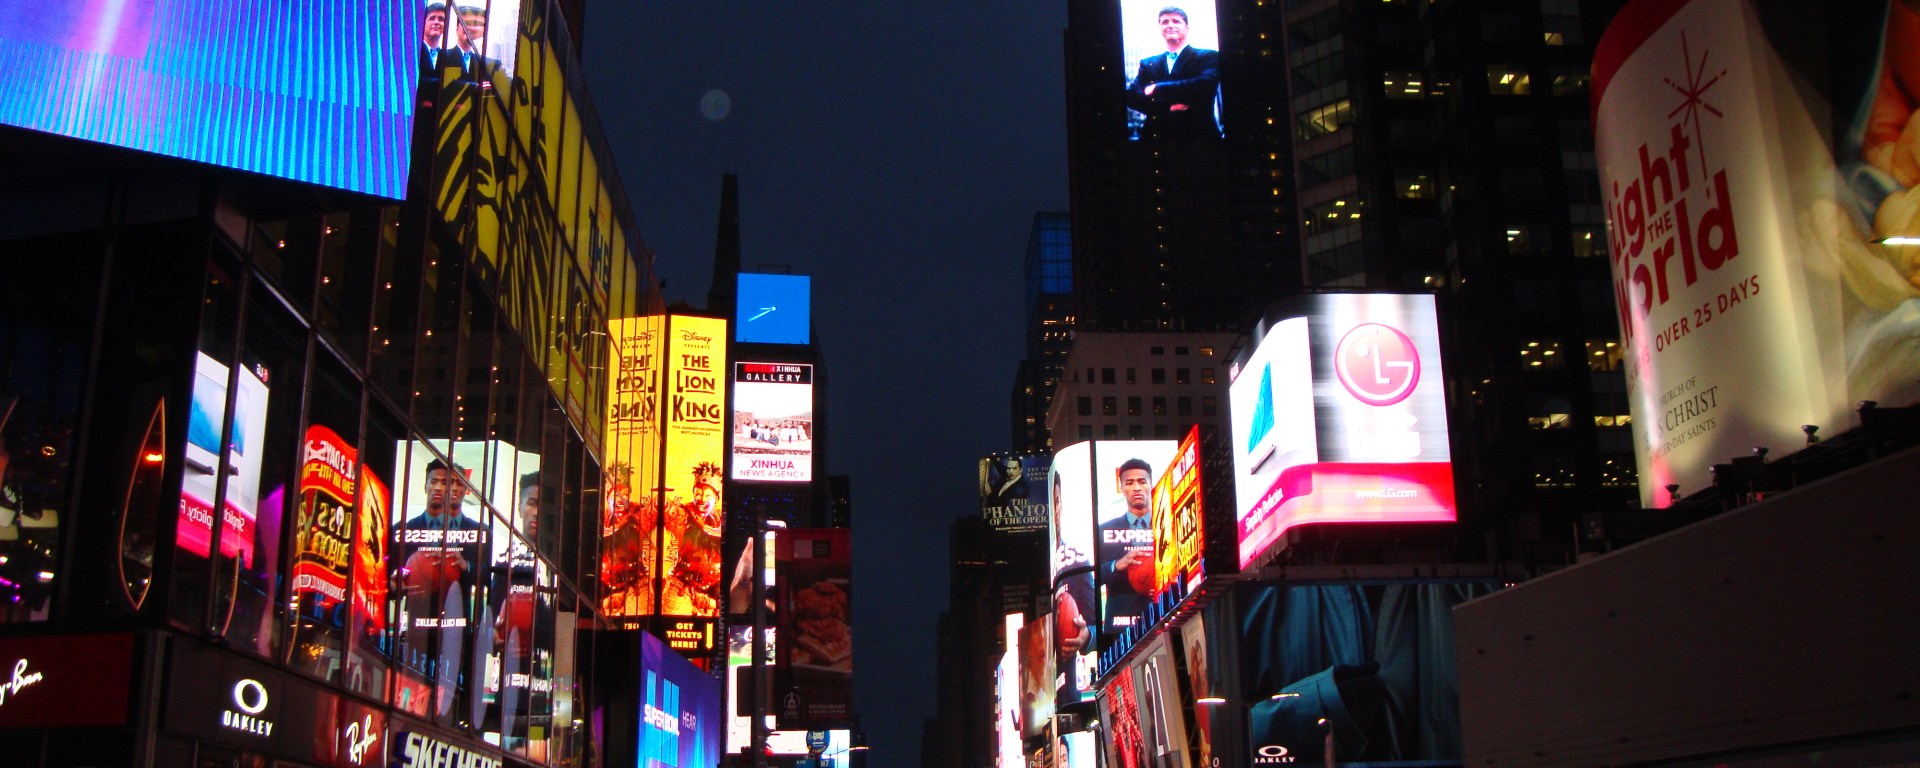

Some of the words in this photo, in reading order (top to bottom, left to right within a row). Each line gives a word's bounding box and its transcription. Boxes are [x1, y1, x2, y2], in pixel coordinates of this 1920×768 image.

[1609, 123, 1690, 267] Light
[1647, 210, 1673, 243] THE
[1616, 168, 1739, 349] World
[1656, 317, 1690, 352] OVER
[1694, 303, 1712, 328] 25
[1717, 275, 1760, 314] DAYS
[682, 354, 710, 368] THE
[776, 365, 802, 374] XINHUA
[676, 370, 715, 393] LION
[746, 373, 801, 382] GALLERY
[1685, 376, 1697, 391] OF
[672, 394, 720, 422] KING
[1665, 385, 1718, 431] CHRIST
[1687, 417, 1716, 440] SAINTS
[750, 460, 795, 469] XINHUA
[667, 631, 702, 639] TICKETS
[221, 710, 273, 736] OAKLEY
[644, 703, 665, 729] SUPER
[682, 710, 697, 732] HEAR
